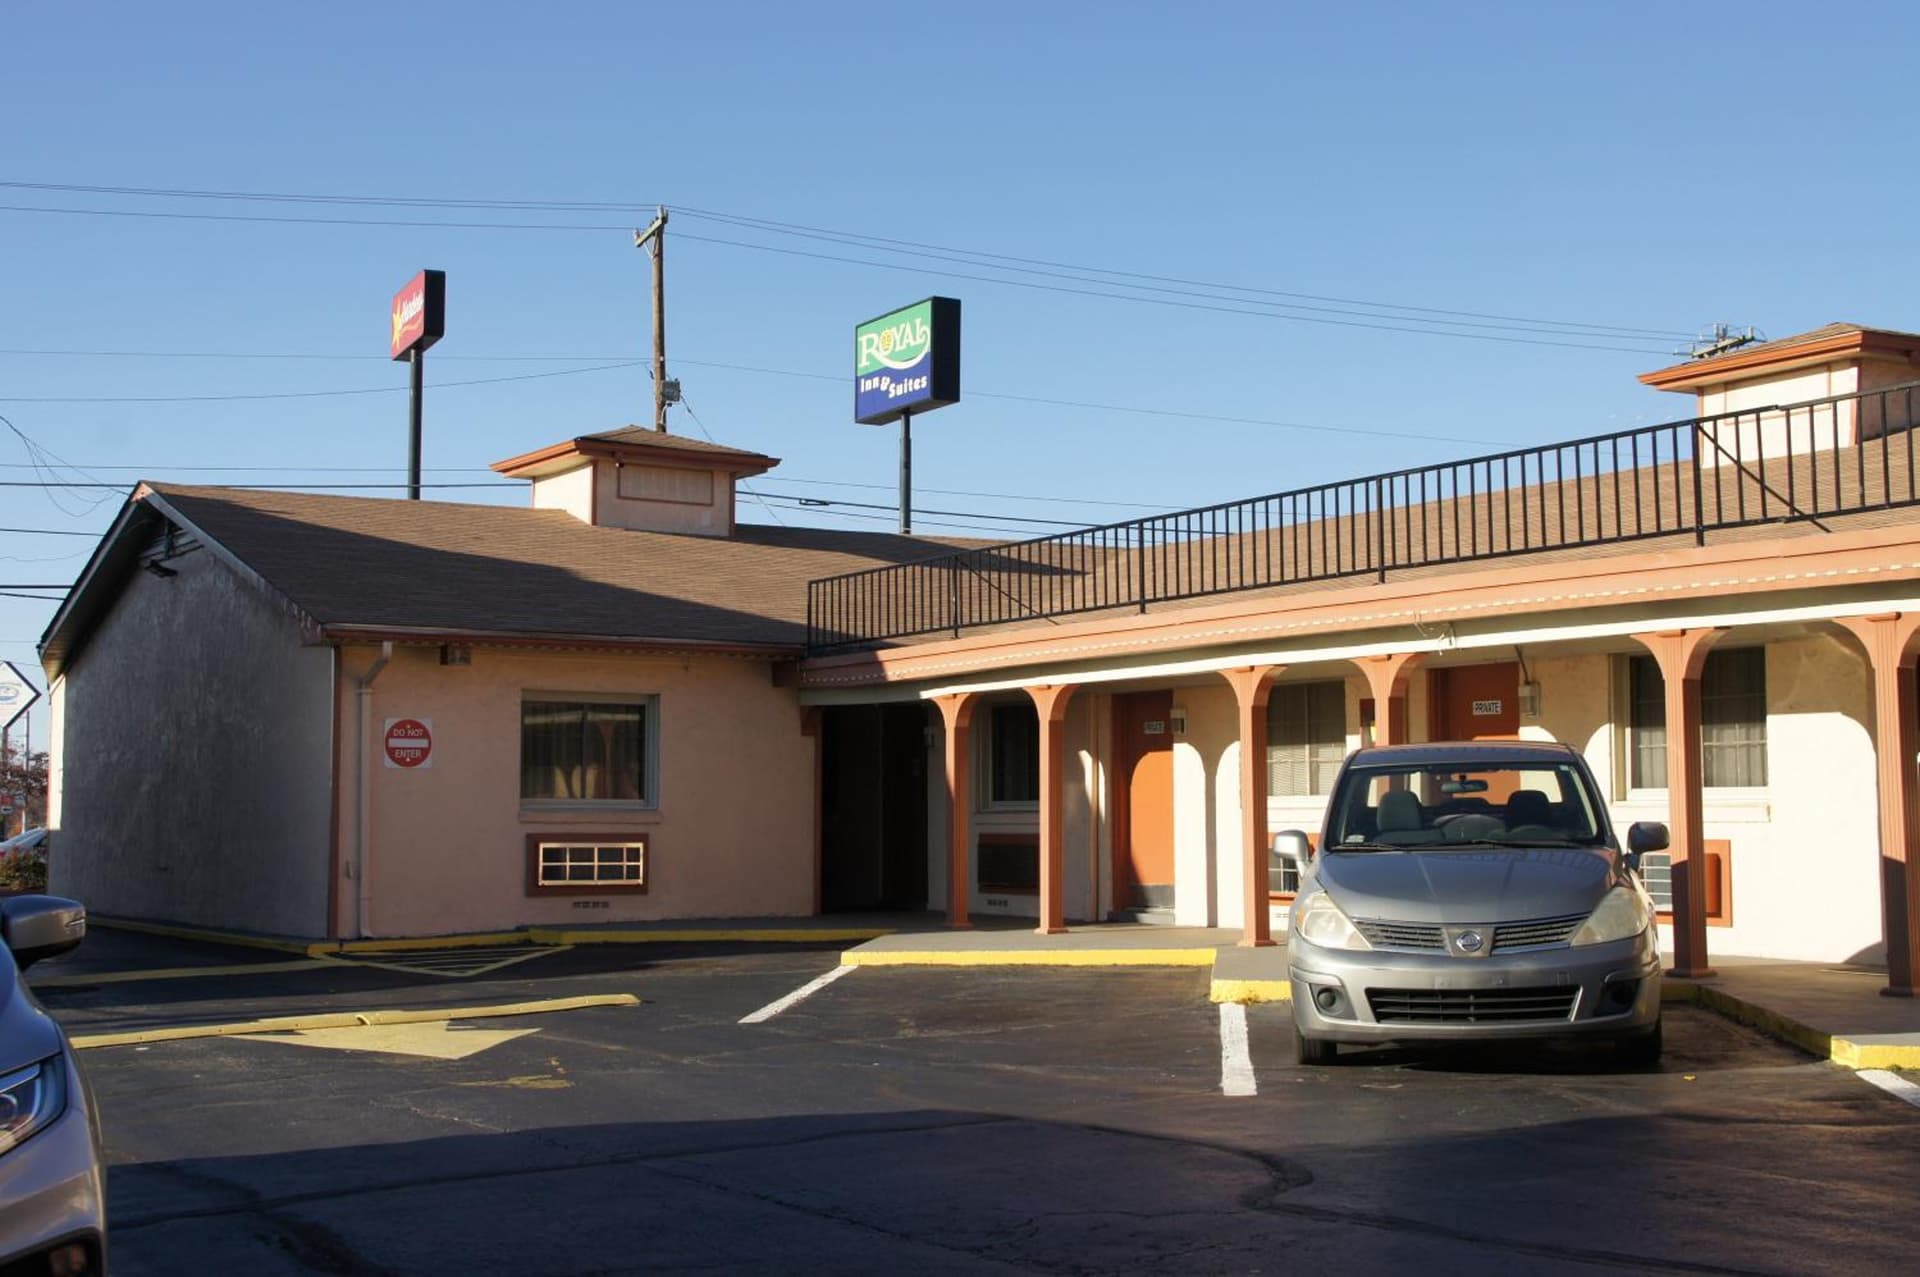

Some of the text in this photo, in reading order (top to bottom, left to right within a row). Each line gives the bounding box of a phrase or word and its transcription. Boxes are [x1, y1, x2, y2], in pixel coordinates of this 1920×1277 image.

[857, 318, 930, 370] ROYAL
[860, 376, 928, 399] Inn & Suites
[1474, 702, 1500, 713] PRIVATE
[393, 728, 423, 737] DO NOT
[395, 749, 421, 758] ENTER
